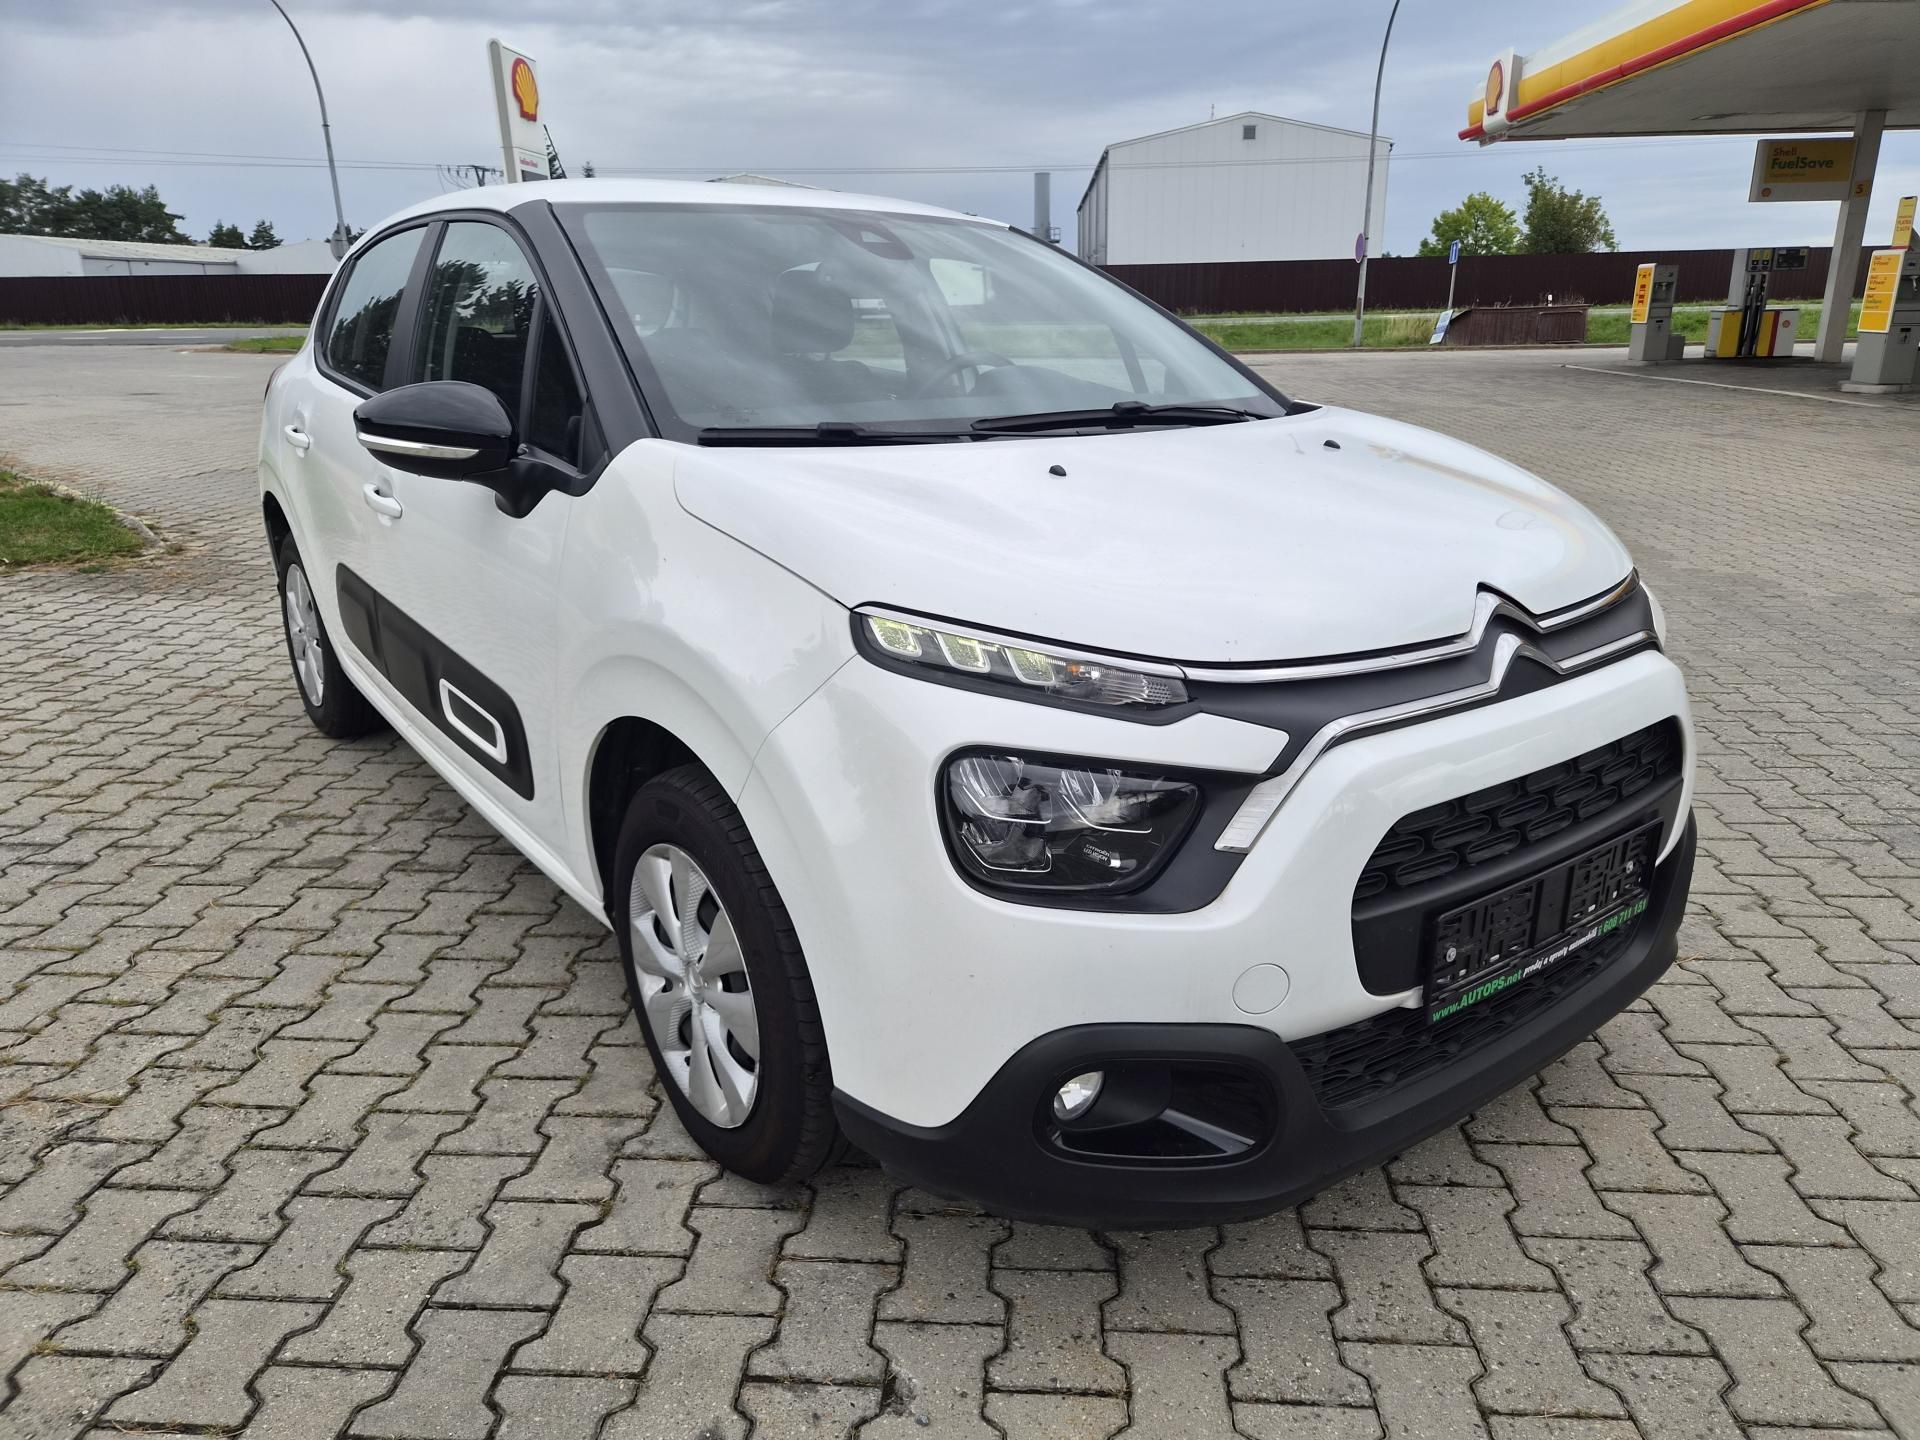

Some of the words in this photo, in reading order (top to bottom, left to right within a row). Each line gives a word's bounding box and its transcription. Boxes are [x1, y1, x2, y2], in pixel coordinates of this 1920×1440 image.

[1773, 147, 1798, 157] Shell
[1771, 157, 1834, 170] FuelSave
[1432, 969, 1522, 1022] www.AUTOPS.net
[1619, 906, 1632, 924] 711
